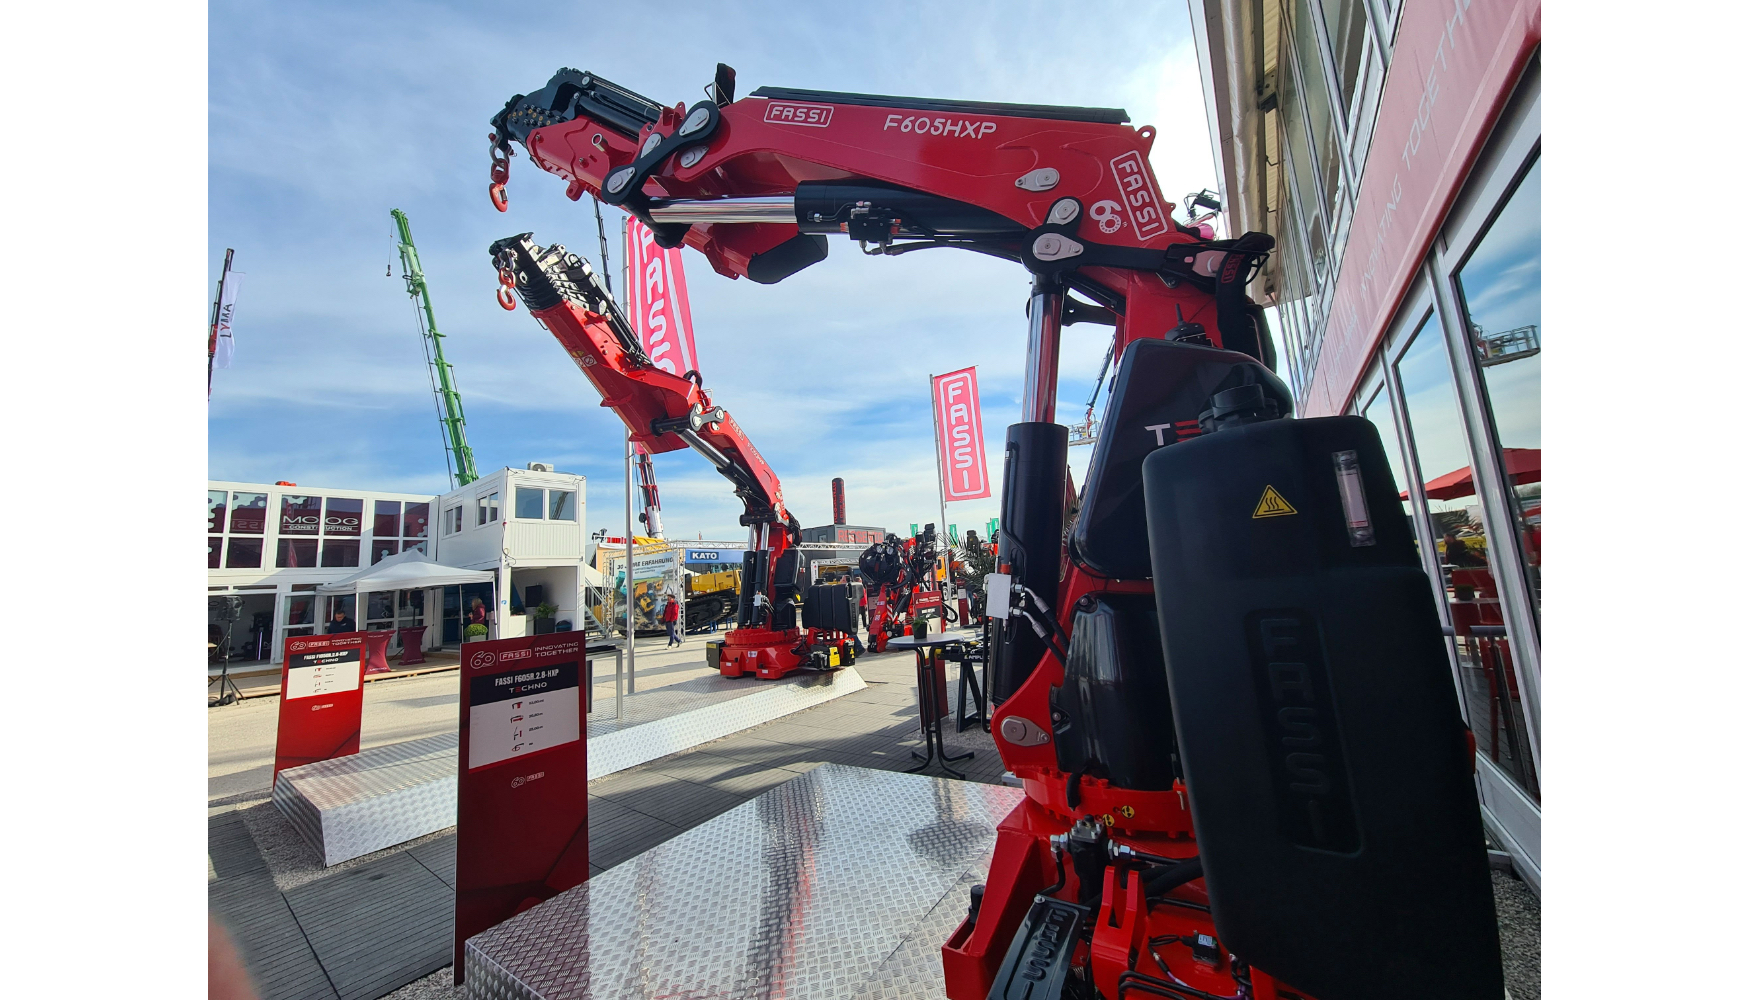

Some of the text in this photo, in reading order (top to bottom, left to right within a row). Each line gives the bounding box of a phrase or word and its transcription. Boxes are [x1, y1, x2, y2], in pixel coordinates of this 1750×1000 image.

[1402, 0, 1470, 171] TOGETH
[770, 106, 827, 123] FASSI
[883, 114, 997, 139] F605HXP
[1117, 159, 1160, 232] FASSI
[640, 224, 676, 376] FASS
[219, 303, 233, 338] LYMA
[947, 380, 973, 490] FASSI
[282, 516, 358, 526] MOOG
[691, 552, 718, 560] KATO
[534, 641, 579, 651] INNOVATING
[535, 647, 579, 658] TOGETHER
[502, 651, 529, 660] FASSI
[495, 675, 513, 687] FASSI
[509, 681, 548, 694] TECHNO
[1260, 617, 1331, 842] FASSI
